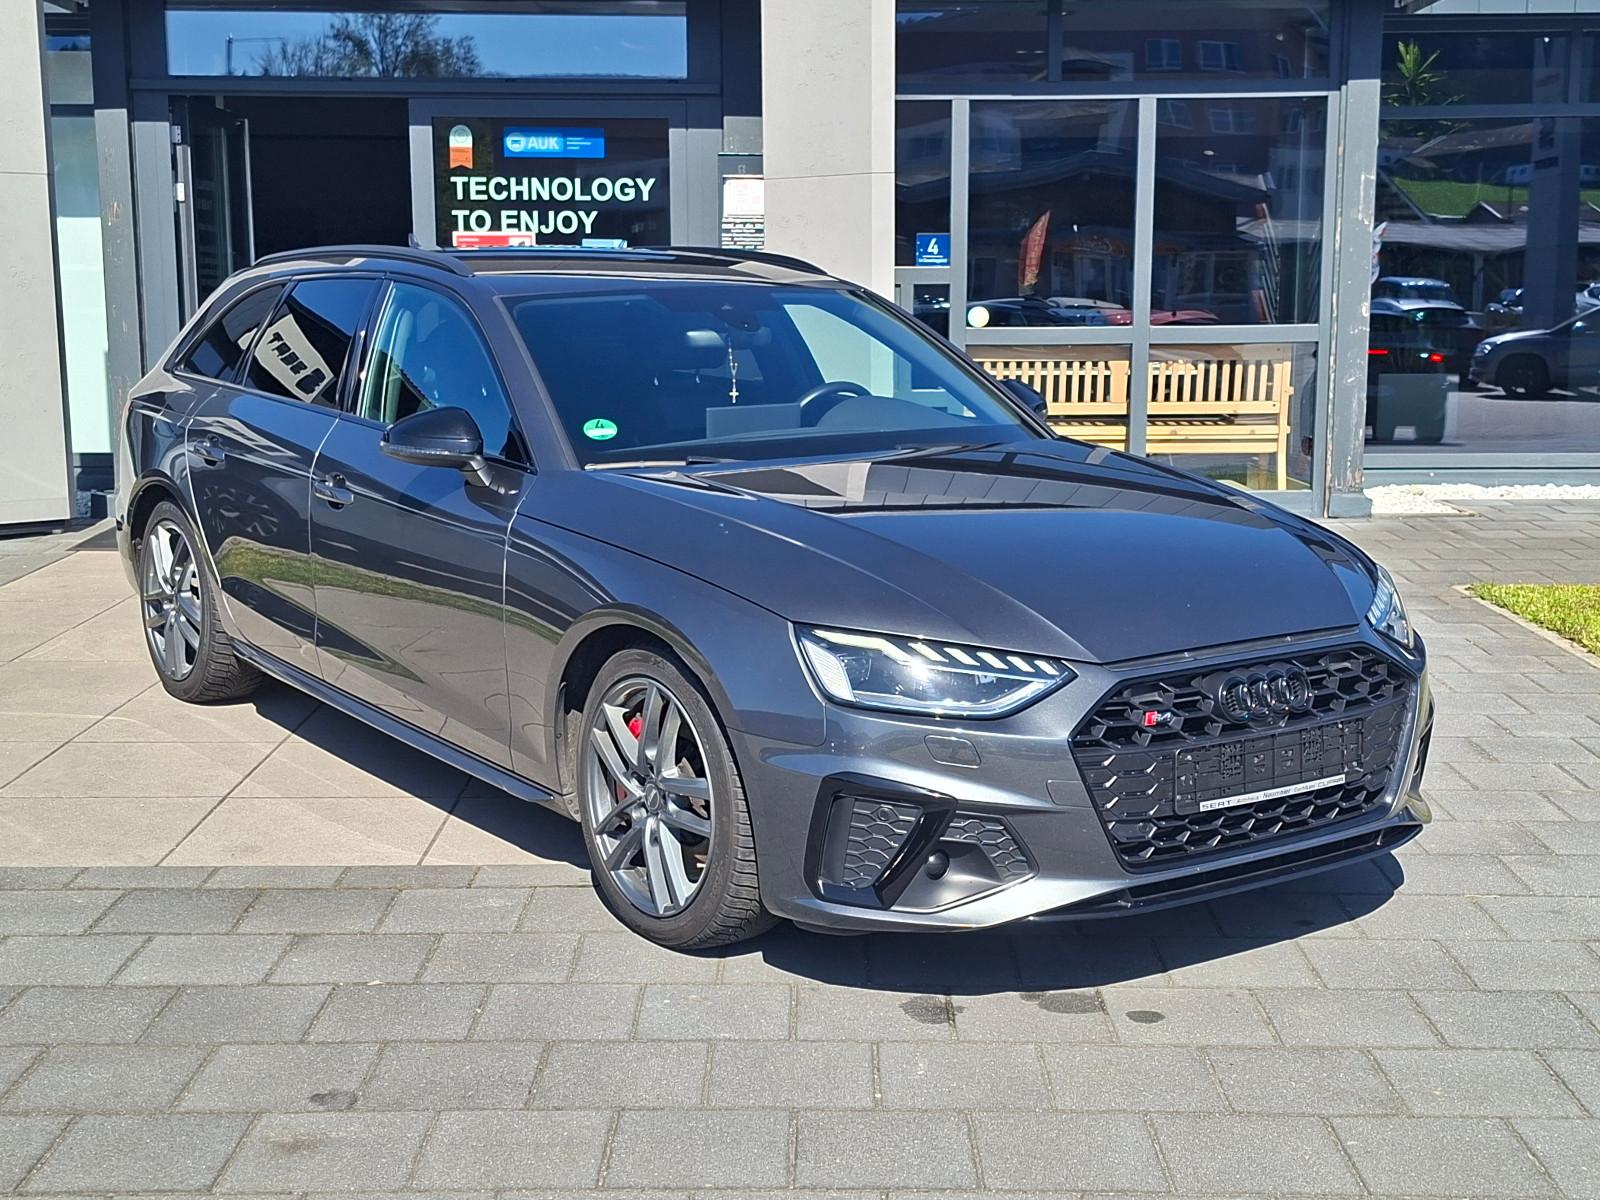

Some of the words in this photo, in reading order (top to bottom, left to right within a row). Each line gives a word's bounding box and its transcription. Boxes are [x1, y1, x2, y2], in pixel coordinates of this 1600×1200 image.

[527, 136, 560, 151] AUK
[450, 176, 656, 202] TECHNOLOGY
[451, 209, 491, 232] TO
[501, 210, 598, 234] ENJOY
[927, 237, 939, 255] 4
[595, 419, 605, 429] 4
[1201, 799, 1232, 810] SEAT
